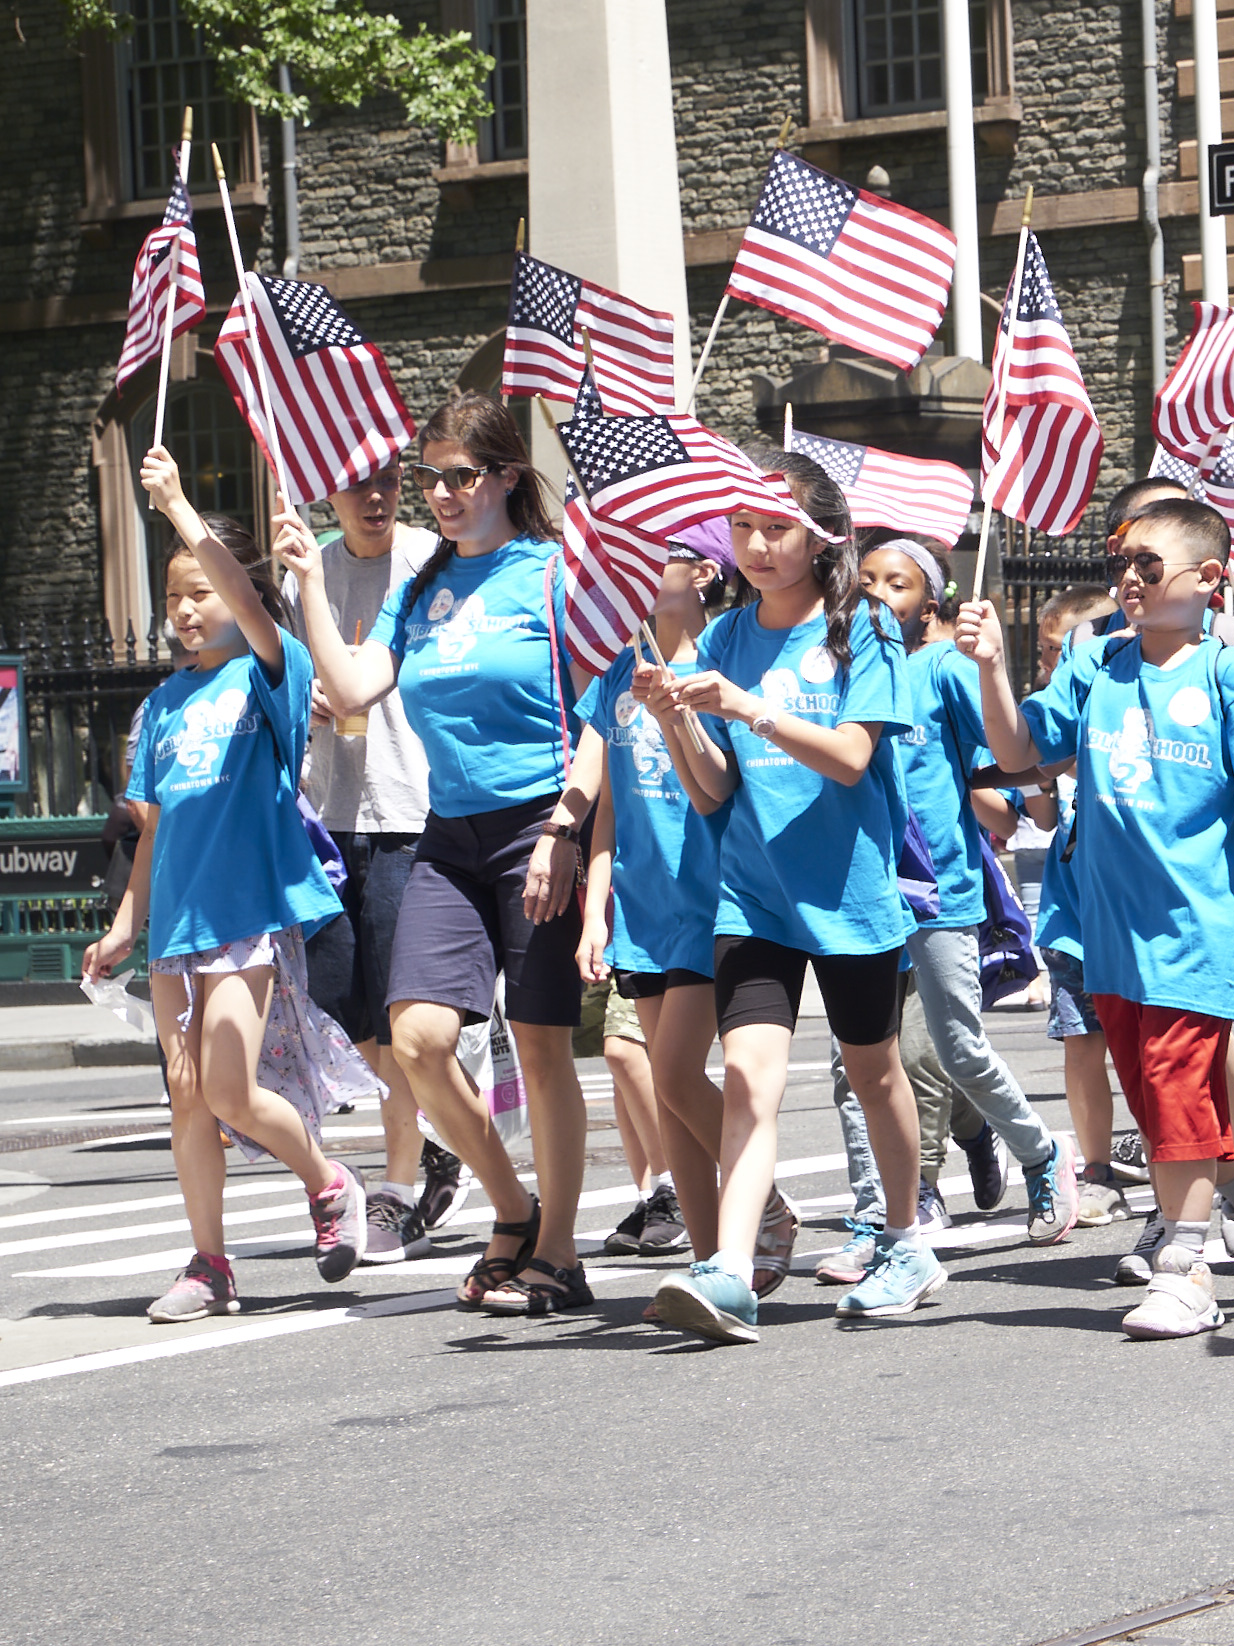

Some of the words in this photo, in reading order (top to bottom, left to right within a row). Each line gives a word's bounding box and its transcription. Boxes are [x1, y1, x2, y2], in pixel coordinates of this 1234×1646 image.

[783, 691, 840, 715] SCHOO
[745, 756, 794, 768] CHINATOWN
[169, 777, 213, 793] CHINATOWN
[214, 774, 231, 786] NYC
[1113, 762, 1138, 795] 2
[0, 845, 78, 877] ubway
